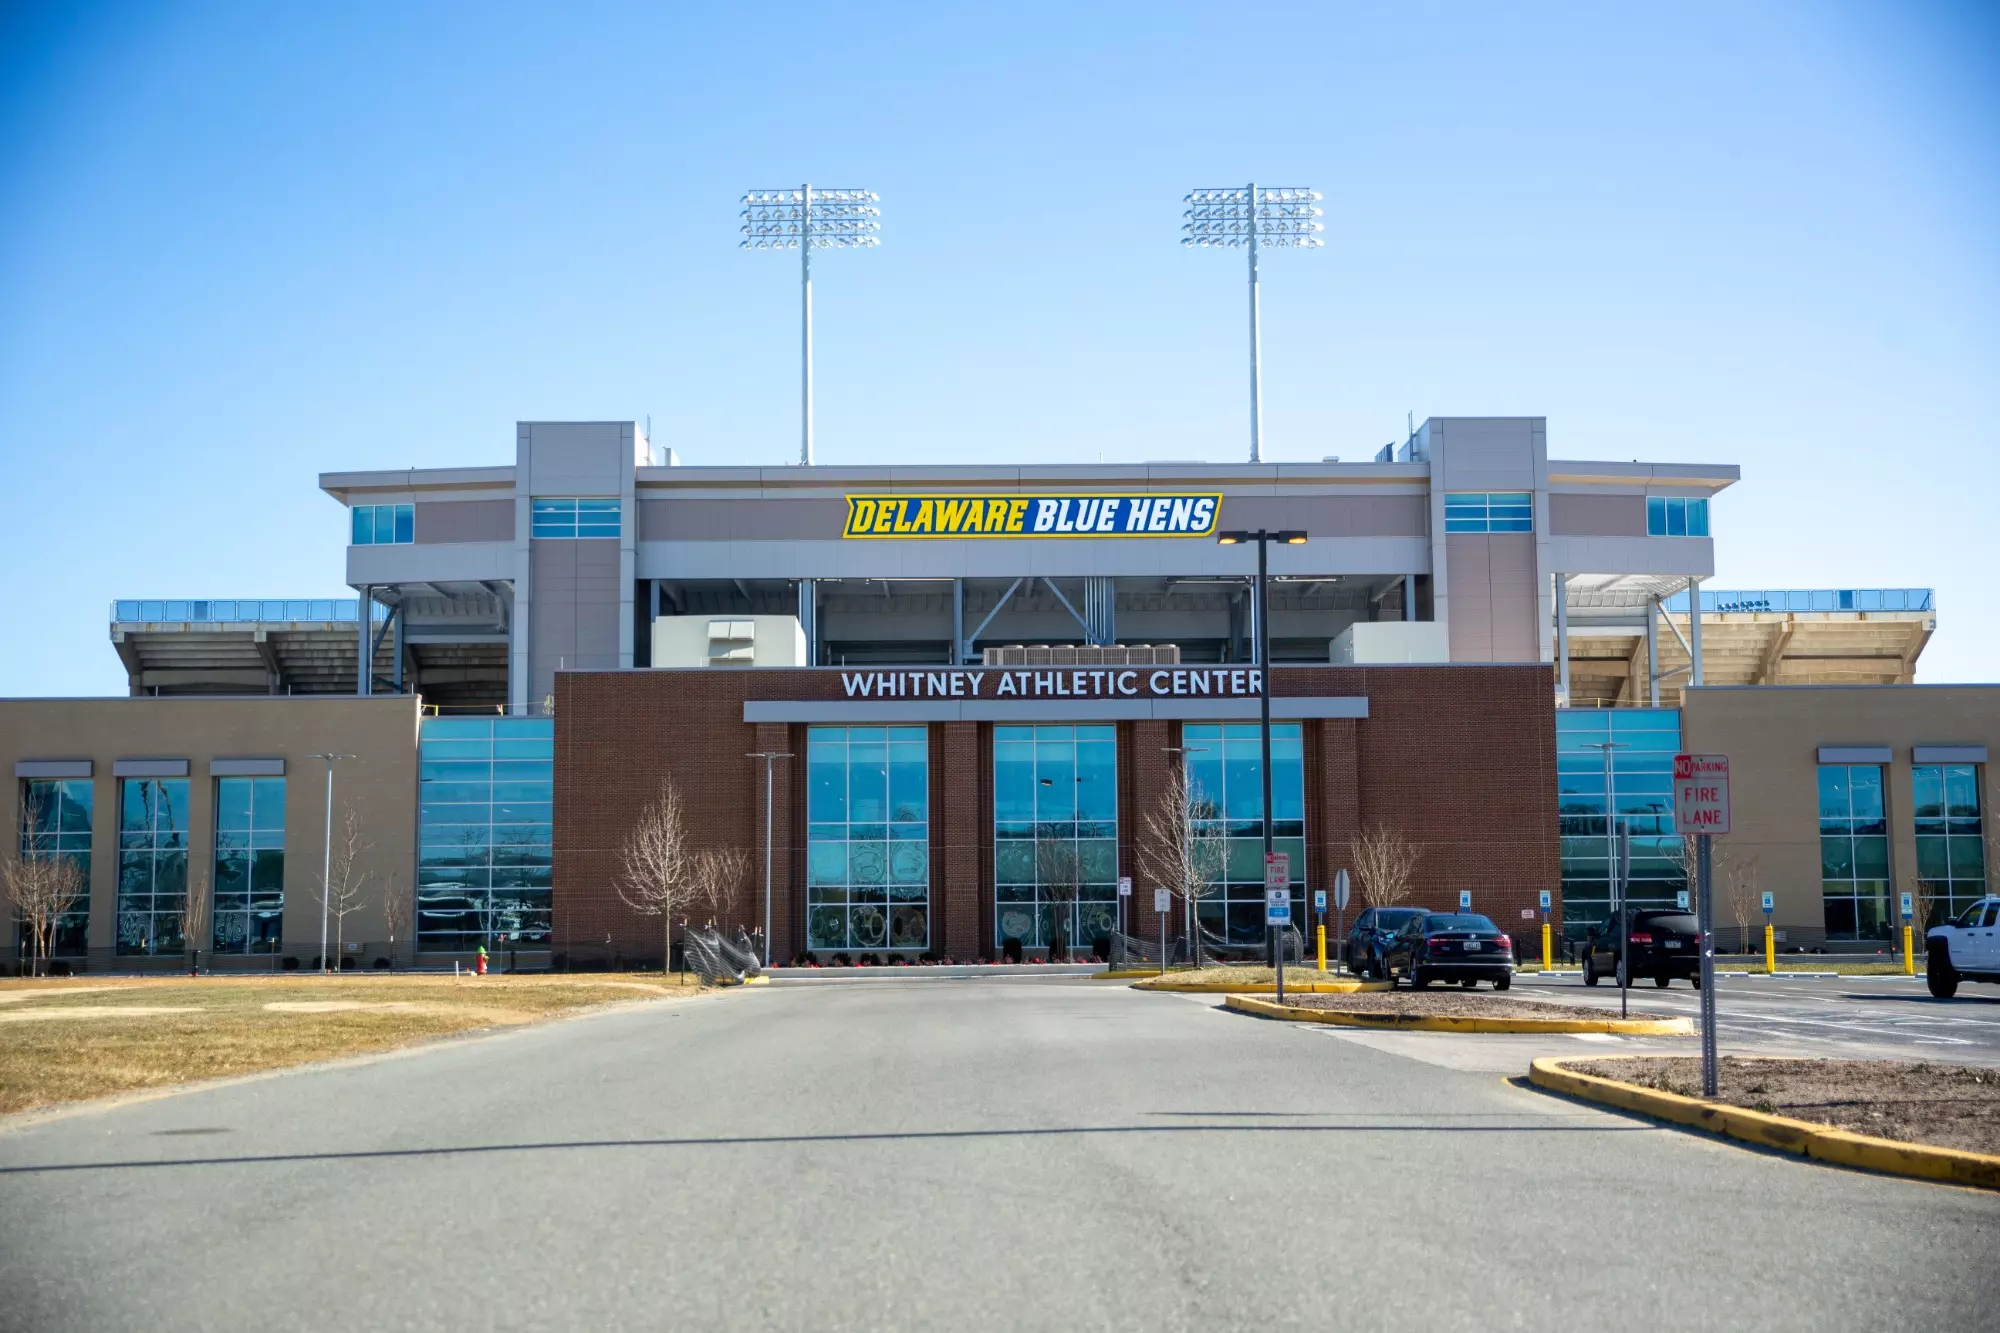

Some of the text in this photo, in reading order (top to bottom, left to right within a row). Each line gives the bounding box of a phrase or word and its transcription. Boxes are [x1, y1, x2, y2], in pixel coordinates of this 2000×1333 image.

[852, 498, 1214, 532] DELAWARE BLUE HENS
[841, 670, 1262, 697] WHITNEY ATHLETIC CENTER
[1675, 759, 1727, 775] NO PARKING
[1684, 787, 1719, 802] FIRE
[1682, 809, 1722, 825] LANE
[1270, 866, 1285, 874] FIRE
[1269, 876, 1286, 884] LANE
